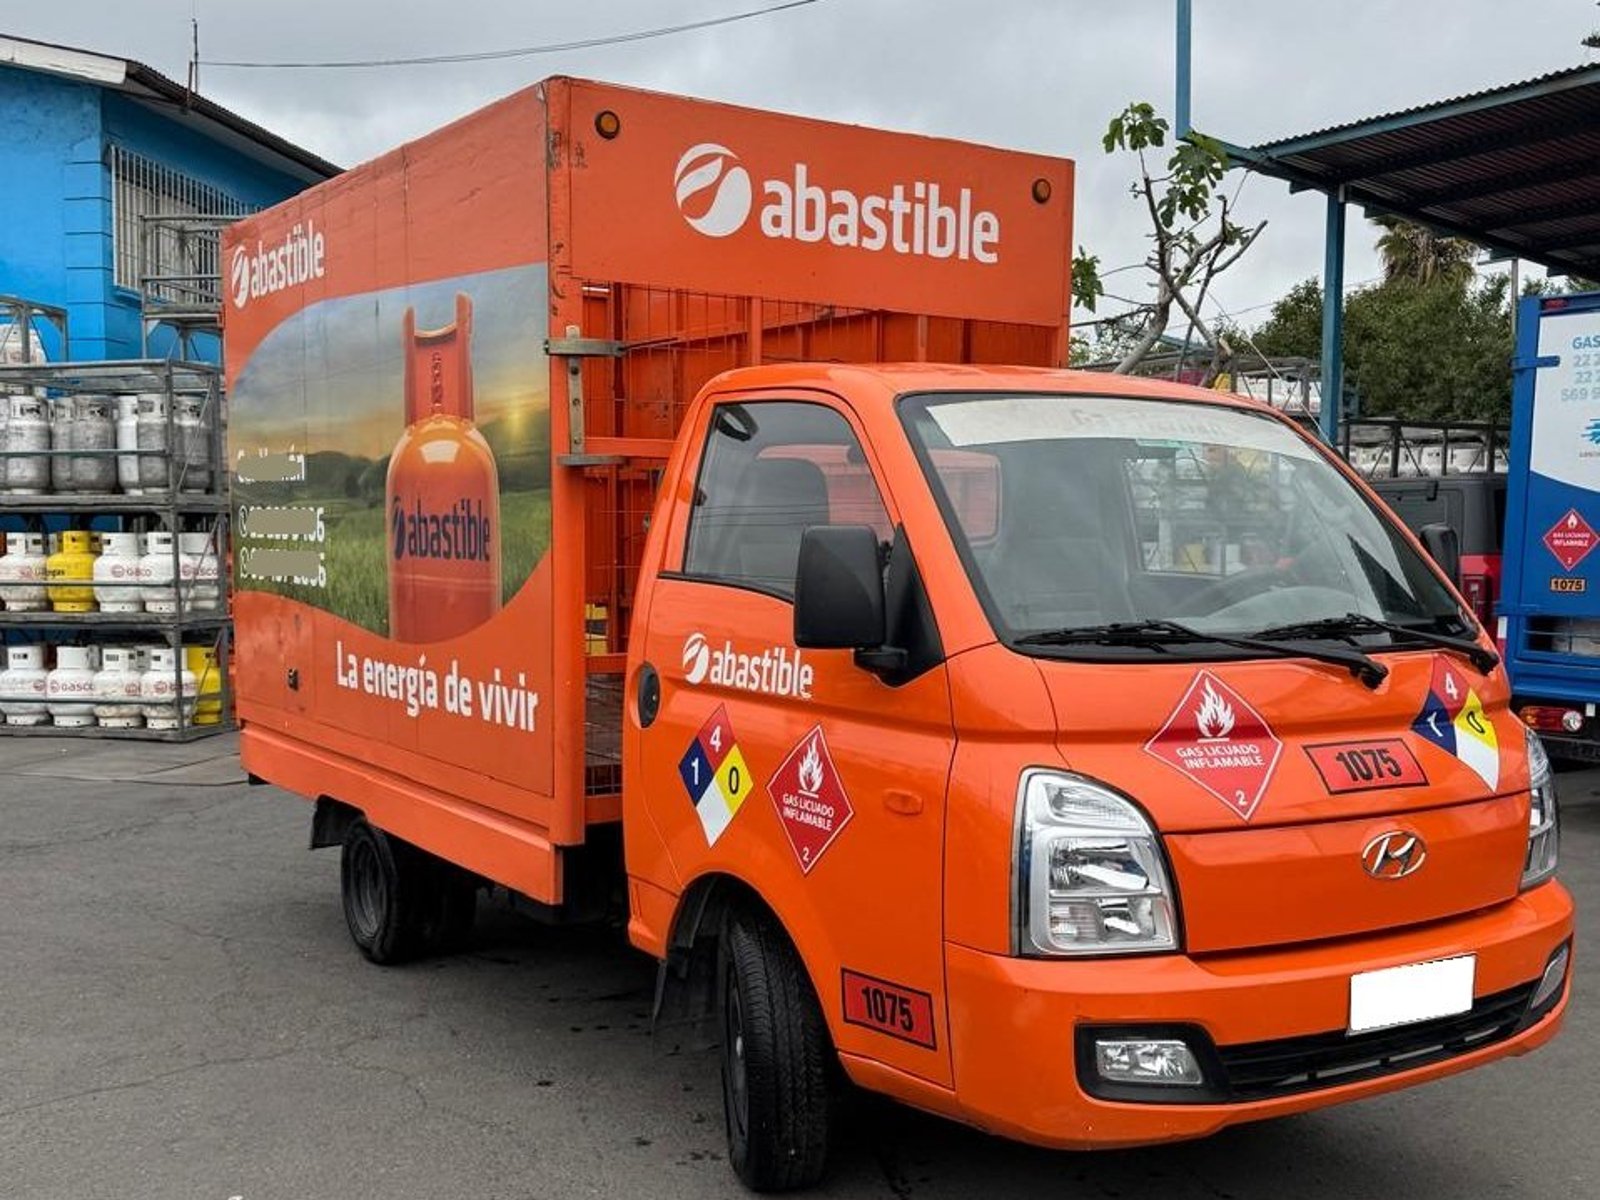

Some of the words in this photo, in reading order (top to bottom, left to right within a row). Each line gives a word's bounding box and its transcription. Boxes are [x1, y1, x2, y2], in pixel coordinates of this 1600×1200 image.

[760, 163, 999, 263] abastible
[251, 219, 325, 299] abastible
[408, 498, 490, 562] abastible
[1553, 580, 1583, 590] 1075
[710, 640, 813, 699] abastible
[336, 641, 358, 690] La
[363, 653, 438, 717] energía
[444, 660, 472, 717] de
[478, 668, 538, 732] vivir
[1445, 672, 1458, 700] 4
[1427, 711, 1444, 738] 1
[1466, 711, 1486, 734] 0
[709, 725, 722, 753] 4
[1176, 747, 1204, 758] GAS
[1203, 744, 1260, 757] LICUADO
[690, 757, 700, 785] 1
[1185, 755, 1266, 769] INFLAMABLE
[1336, 748, 1403, 782] 1075
[728, 766, 740, 795] 0
[782, 793, 799, 808] GAS
[798, 797, 834, 819] LICUADO
[1235, 790, 1248, 805] 2
[782, 806, 833, 832] INFLAMABLE
[802, 846, 810, 862] 2
[861, 986, 914, 1031] 1075
